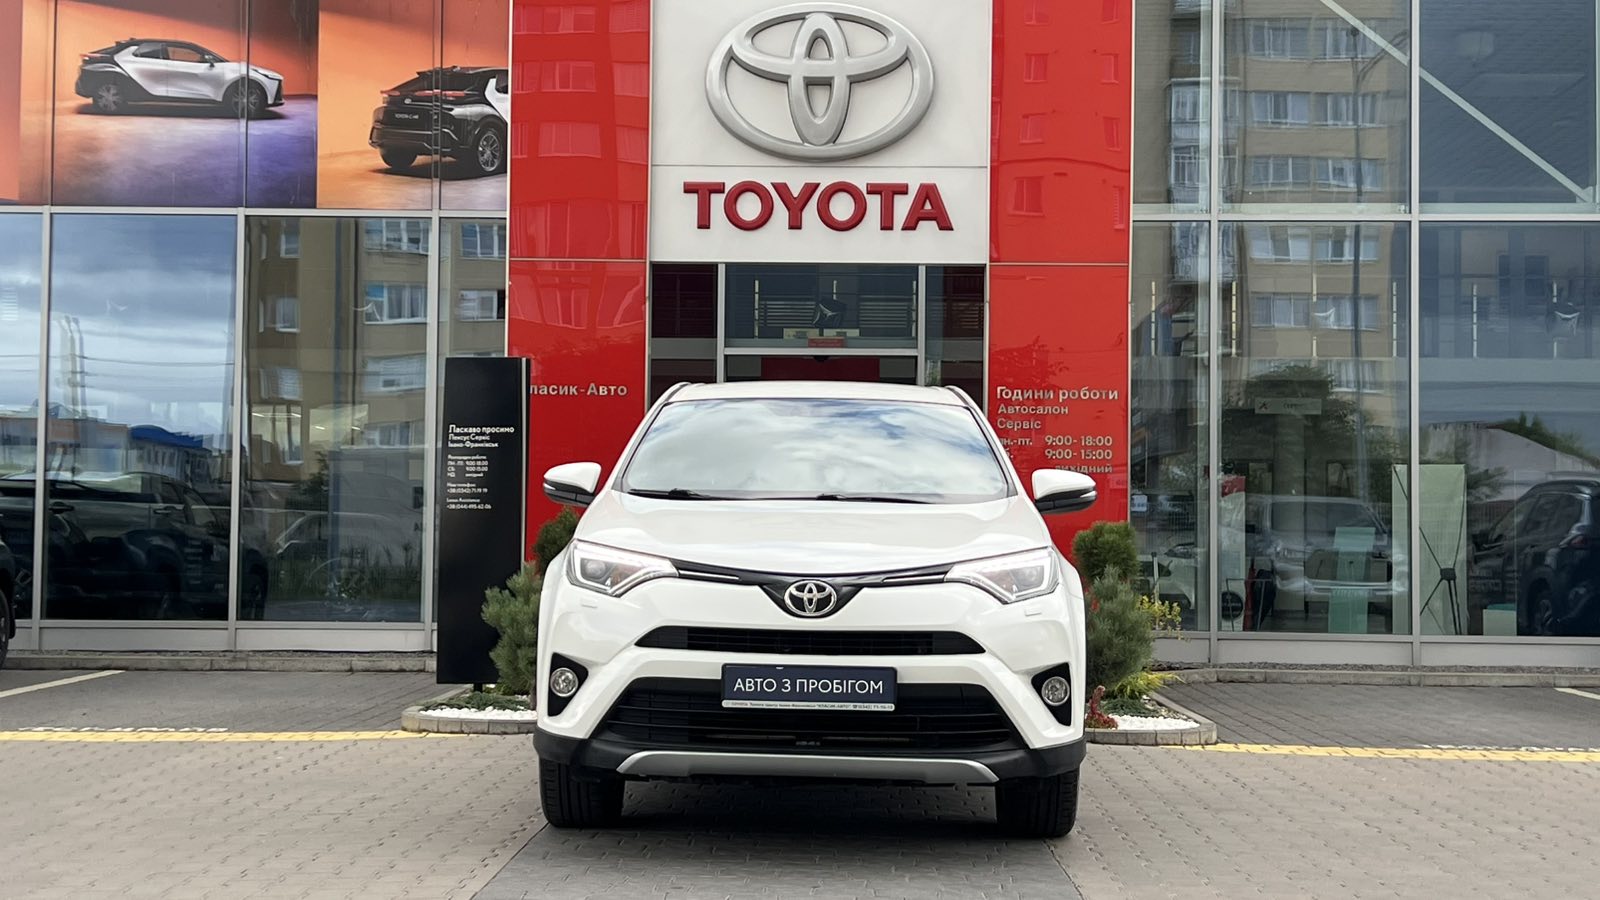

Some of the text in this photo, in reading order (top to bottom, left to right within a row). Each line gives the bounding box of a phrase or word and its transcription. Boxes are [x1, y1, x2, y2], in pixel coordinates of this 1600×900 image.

[683, 180, 954, 232] TOYOTA
[529, 383, 628, 396] ласик-Авто
[996, 386, 1119, 402] Години роботи
[998, 404, 1069, 415] Автосалон
[482, 426, 515, 434] просимо
[997, 418, 1042, 431] Сервіс
[733, 678, 884, 694] АВТО З ПРОБІГОМ
